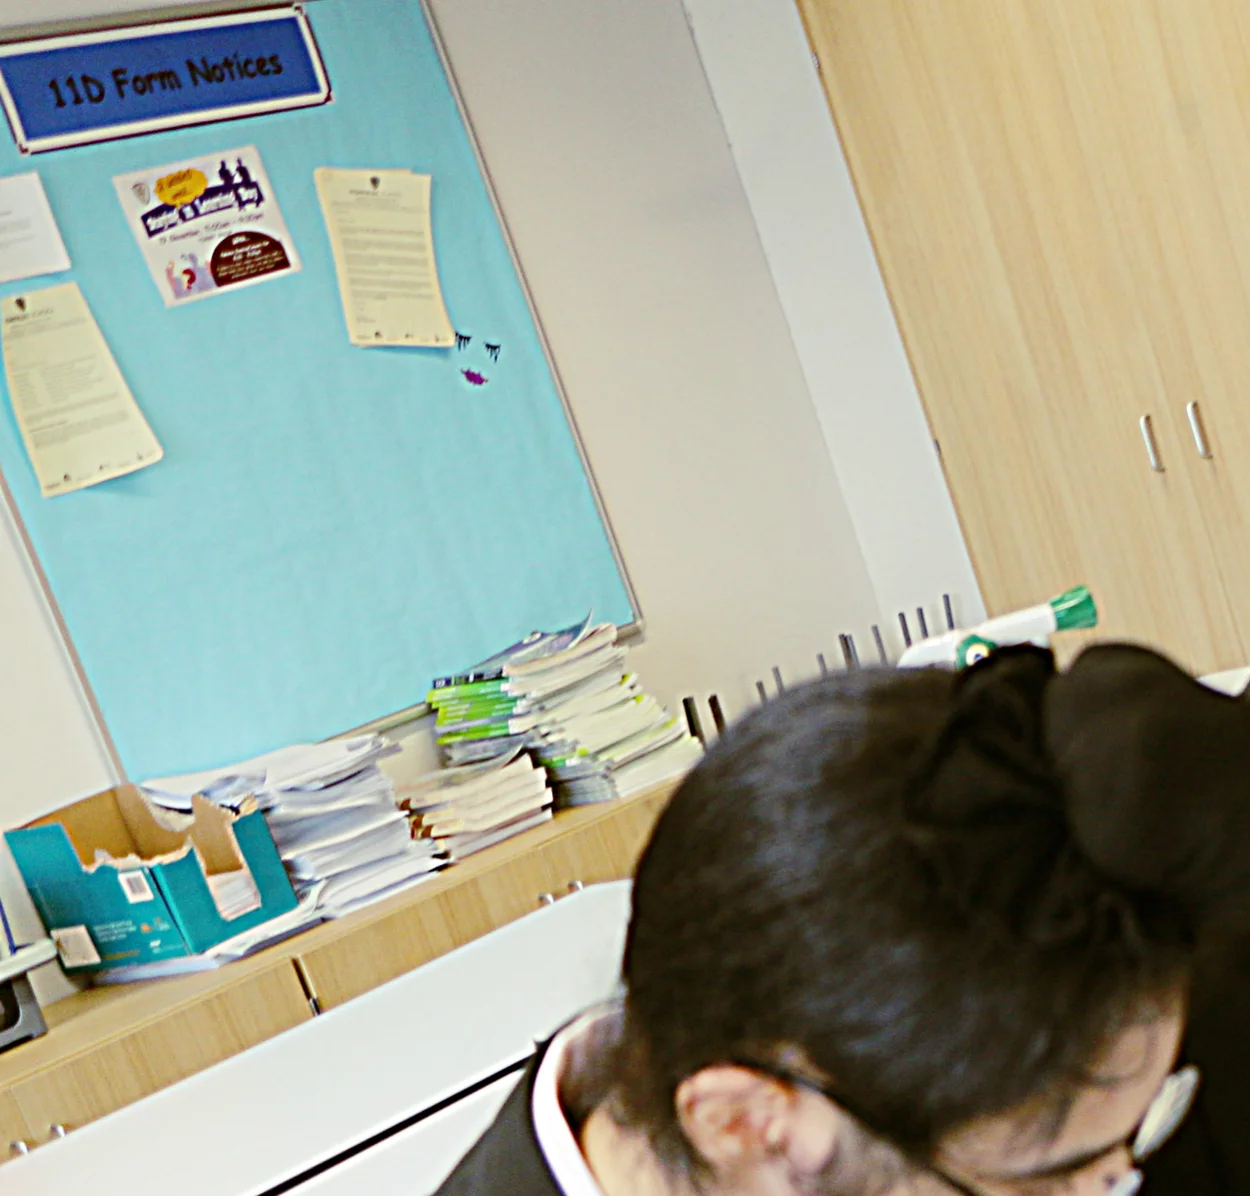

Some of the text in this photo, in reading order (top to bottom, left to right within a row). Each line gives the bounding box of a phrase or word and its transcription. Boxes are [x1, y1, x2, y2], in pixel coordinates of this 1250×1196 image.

[49, 53, 284, 108] 11D Form Notices
